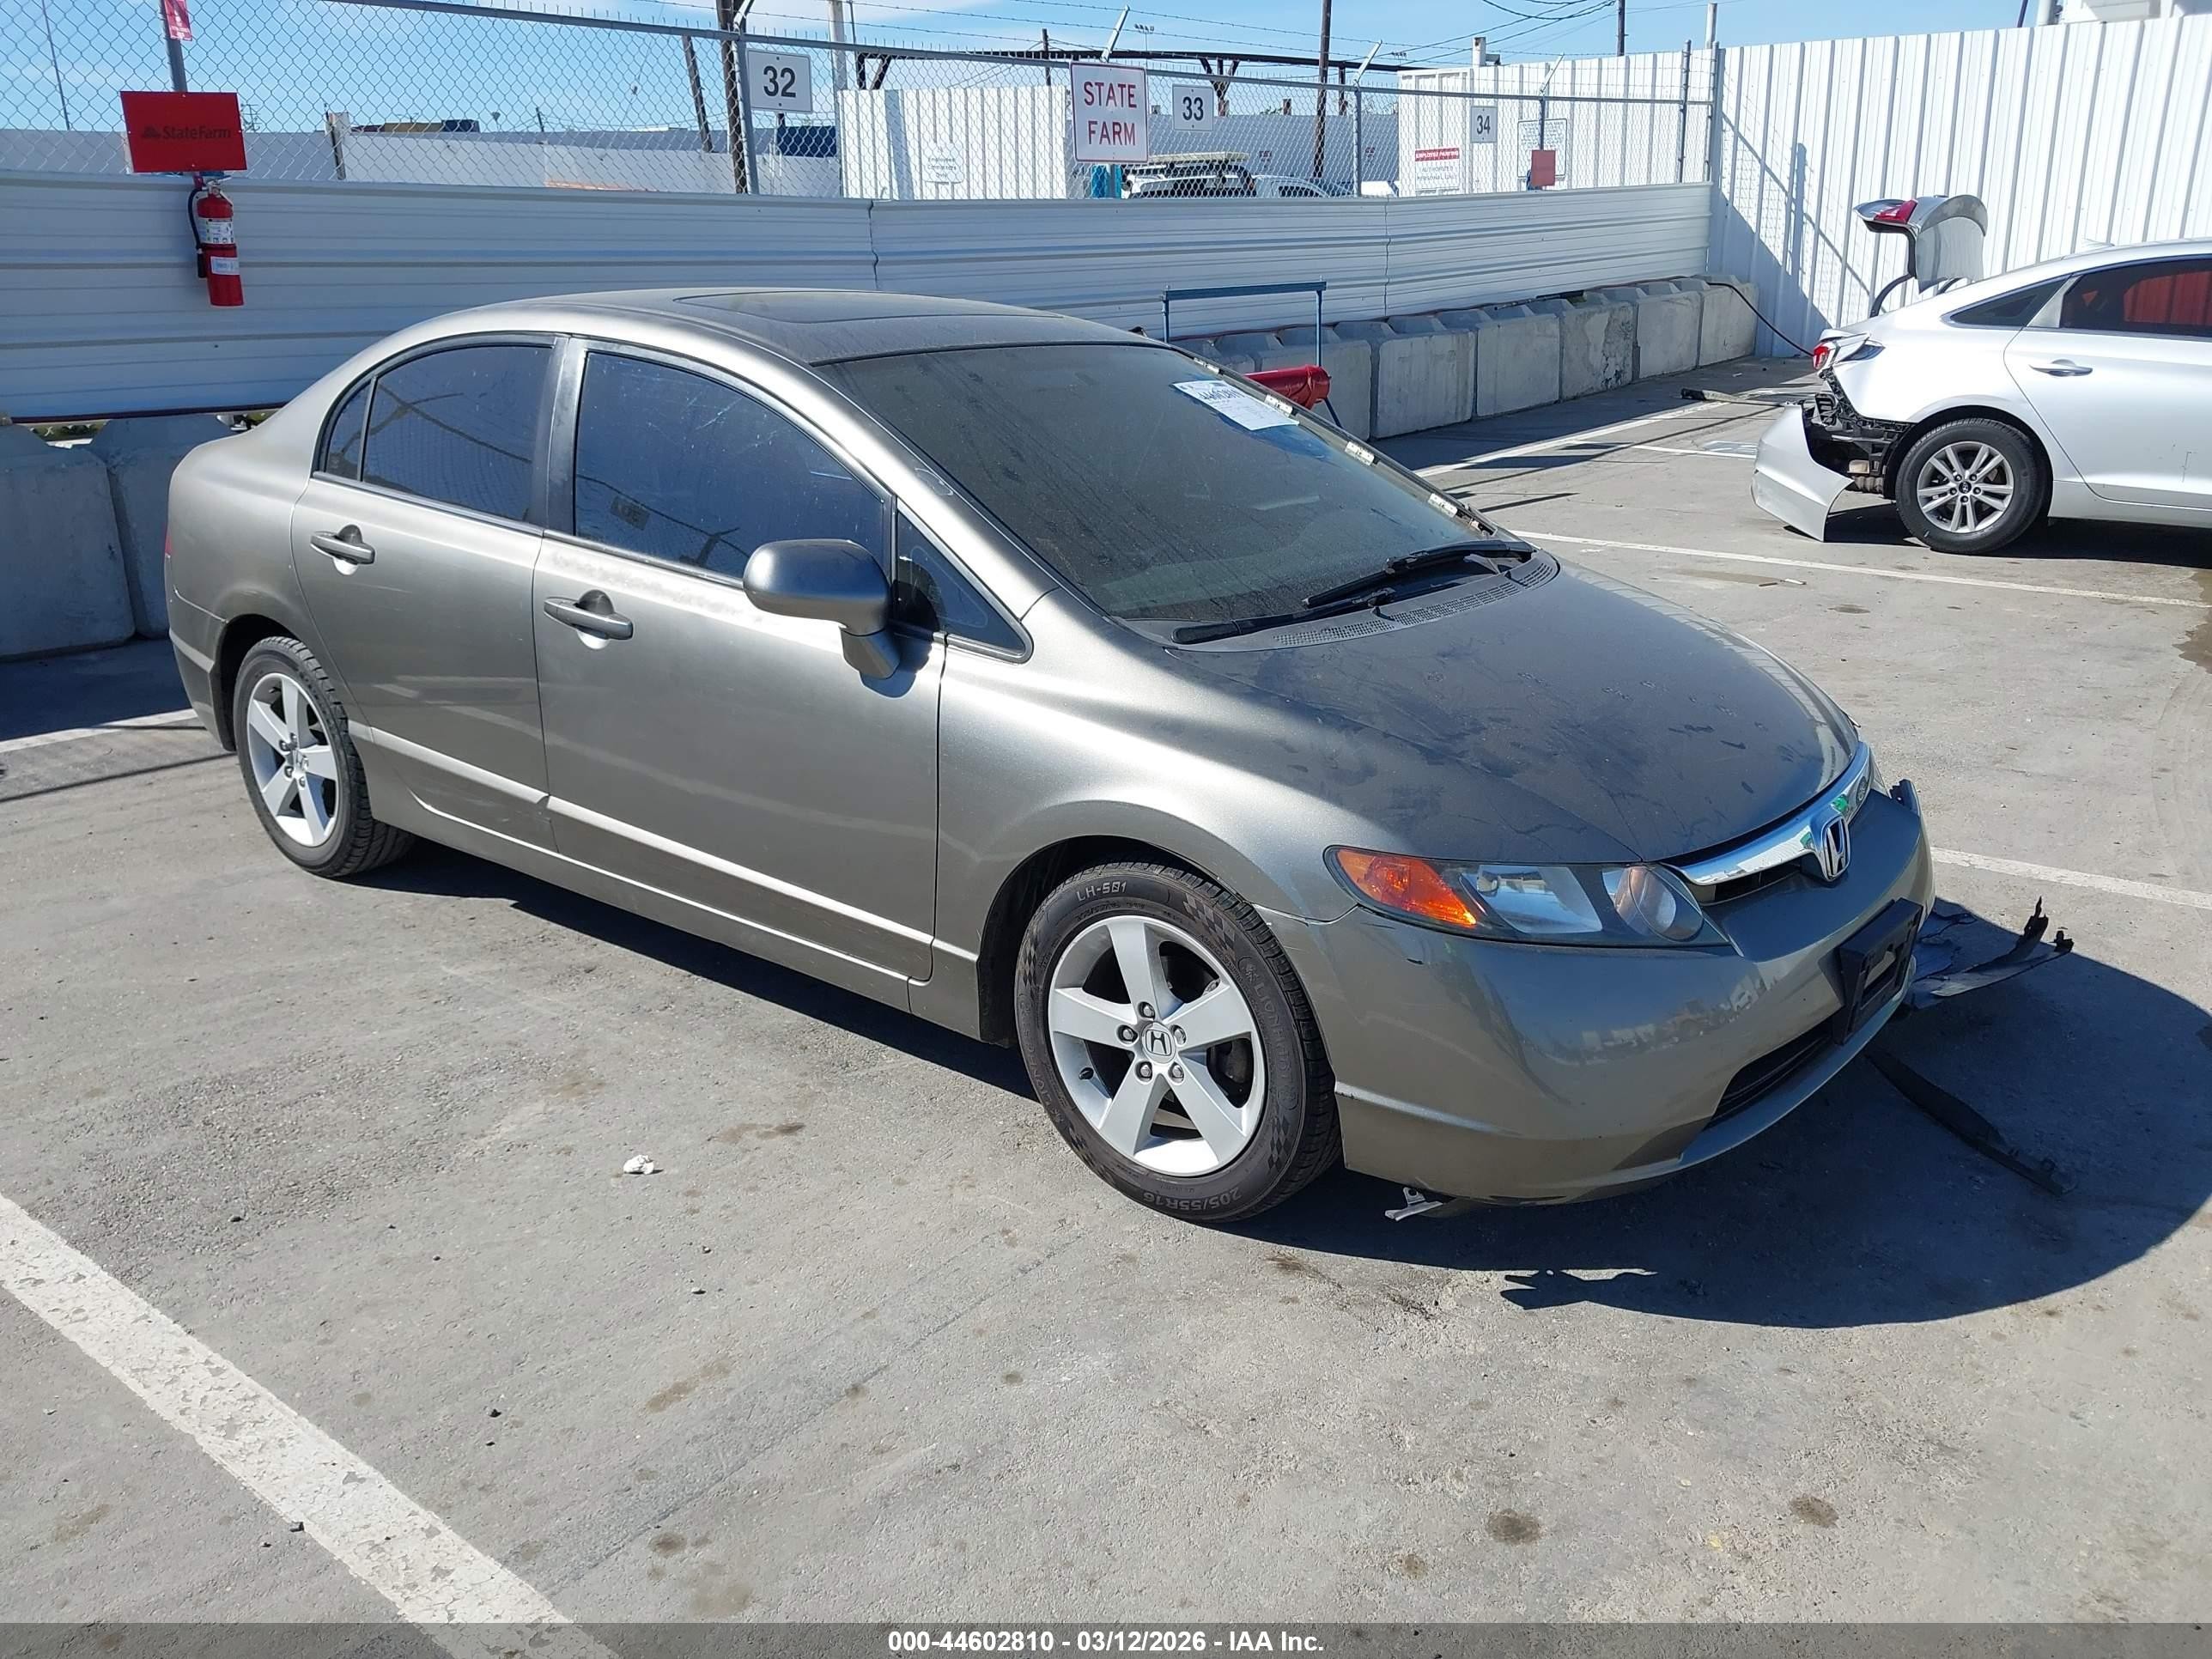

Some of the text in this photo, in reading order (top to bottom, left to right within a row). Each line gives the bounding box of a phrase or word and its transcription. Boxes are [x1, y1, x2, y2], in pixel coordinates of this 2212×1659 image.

[763, 65, 797, 98] 32
[1084, 81, 1138, 109] STATE
[1182, 96, 1205, 121] 33
[1087, 120, 1136, 146] FARM
[1476, 114, 1492, 135] 34
[1143, 1187, 1243, 1211] 205/55R16
